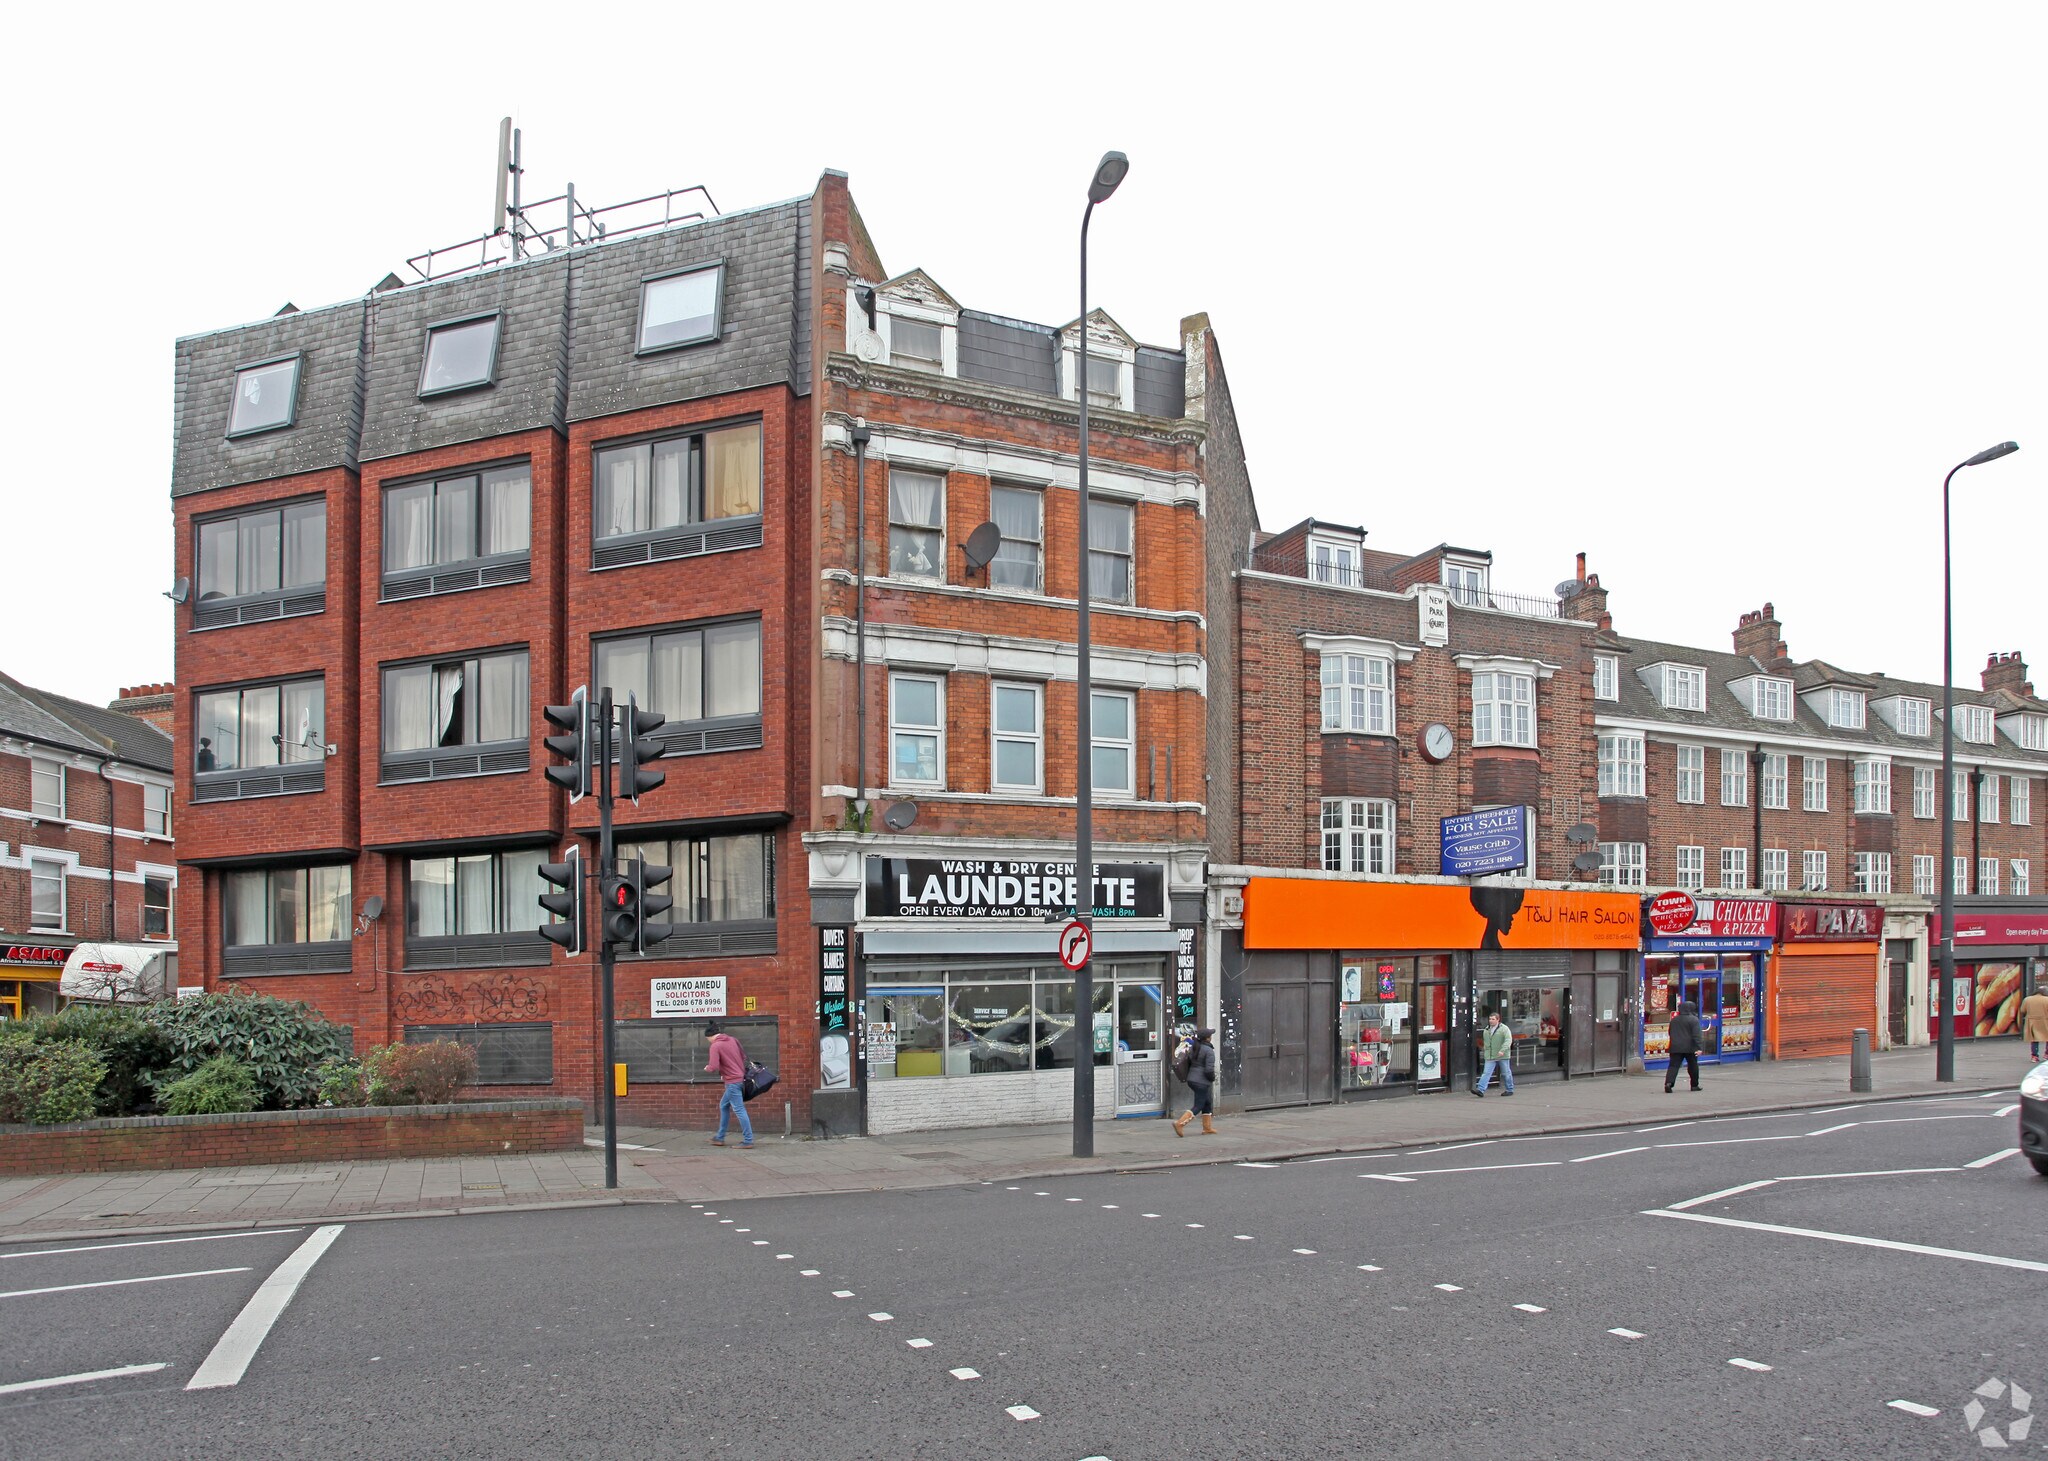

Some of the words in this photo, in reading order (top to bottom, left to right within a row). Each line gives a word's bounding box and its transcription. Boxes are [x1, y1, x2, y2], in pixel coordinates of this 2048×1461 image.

[1429, 596, 1443, 605] NEW
[1429, 607, 1444, 617] PARK
[1429, 618, 1445, 629] COURT
[1445, 816, 1472, 825] ENTIRE
[1474, 808, 1517, 820] FREEHOLD
[1445, 822, 1473, 834] FOR
[1479, 815, 1517, 829] SALE
[1454, 845, 1482, 853] Vause
[1485, 839, 1510, 848] Cribb
[942, 860, 985, 873] WASH
[992, 862, 1003, 874] &
[1010, 862, 1038, 875] DRY
[1045, 863, 1100, 876] CENE
[1455, 861, 1471, 869] 020
[1474, 858, 1494, 866] 7223
[1497, 855, 1513, 863] 1188
[1656, 896, 1687, 906] TOWN
[900, 906, 929, 916] OPEN
[933, 906, 964, 916] EVERY
[968, 906, 987, 916] DAY
[991, 907, 1010, 917] 6AM
[1013, 907, 1026, 917] TO
[1030, 907, 1052, 917] 10PM
[1118, 908, 1136, 917] 8PM
[1524, 905, 1552, 923] T&J
[1655, 911, 1690, 921] CHICKEN
[1716, 901, 1772, 921] CHICKEN
[1659, 922, 1683, 930] PIZZA
[1816, 908, 1868, 933] PAYA
[1177, 928, 1194, 941] DROP
[1722, 922, 1730, 935] &
[1731, 922, 1765, 935] PIZZA
[2006, 928, 2017, 936] Open
[823, 929, 844, 946] DUVETS
[6, 946, 64, 961] ASAFO
[1180, 942, 1192, 955] OFF
[823, 952, 844, 969] BLANKETS
[1177, 955, 1194, 968] WASH
[1177, 968, 1182, 981] &
[1183, 968, 1194, 981] DRY
[1379, 965, 1394, 973] OPEN
[656, 981, 692, 991] GROMYKO
[694, 980, 721, 989] AMEDU
[823, 975, 845, 992] CURTAINS
[1177, 982, 1194, 994] SERVICE
[665, 990, 710, 999] SOLICITORS
[1380, 991, 1396, 1000] NAILS
[1957, 997, 1964, 1005] £2
[824, 997, 845, 1014] Washed
[1177, 996, 1192, 1007] Same
[1181, 1004, 1194, 1015] Day
[829, 1013, 843, 1026] Here
